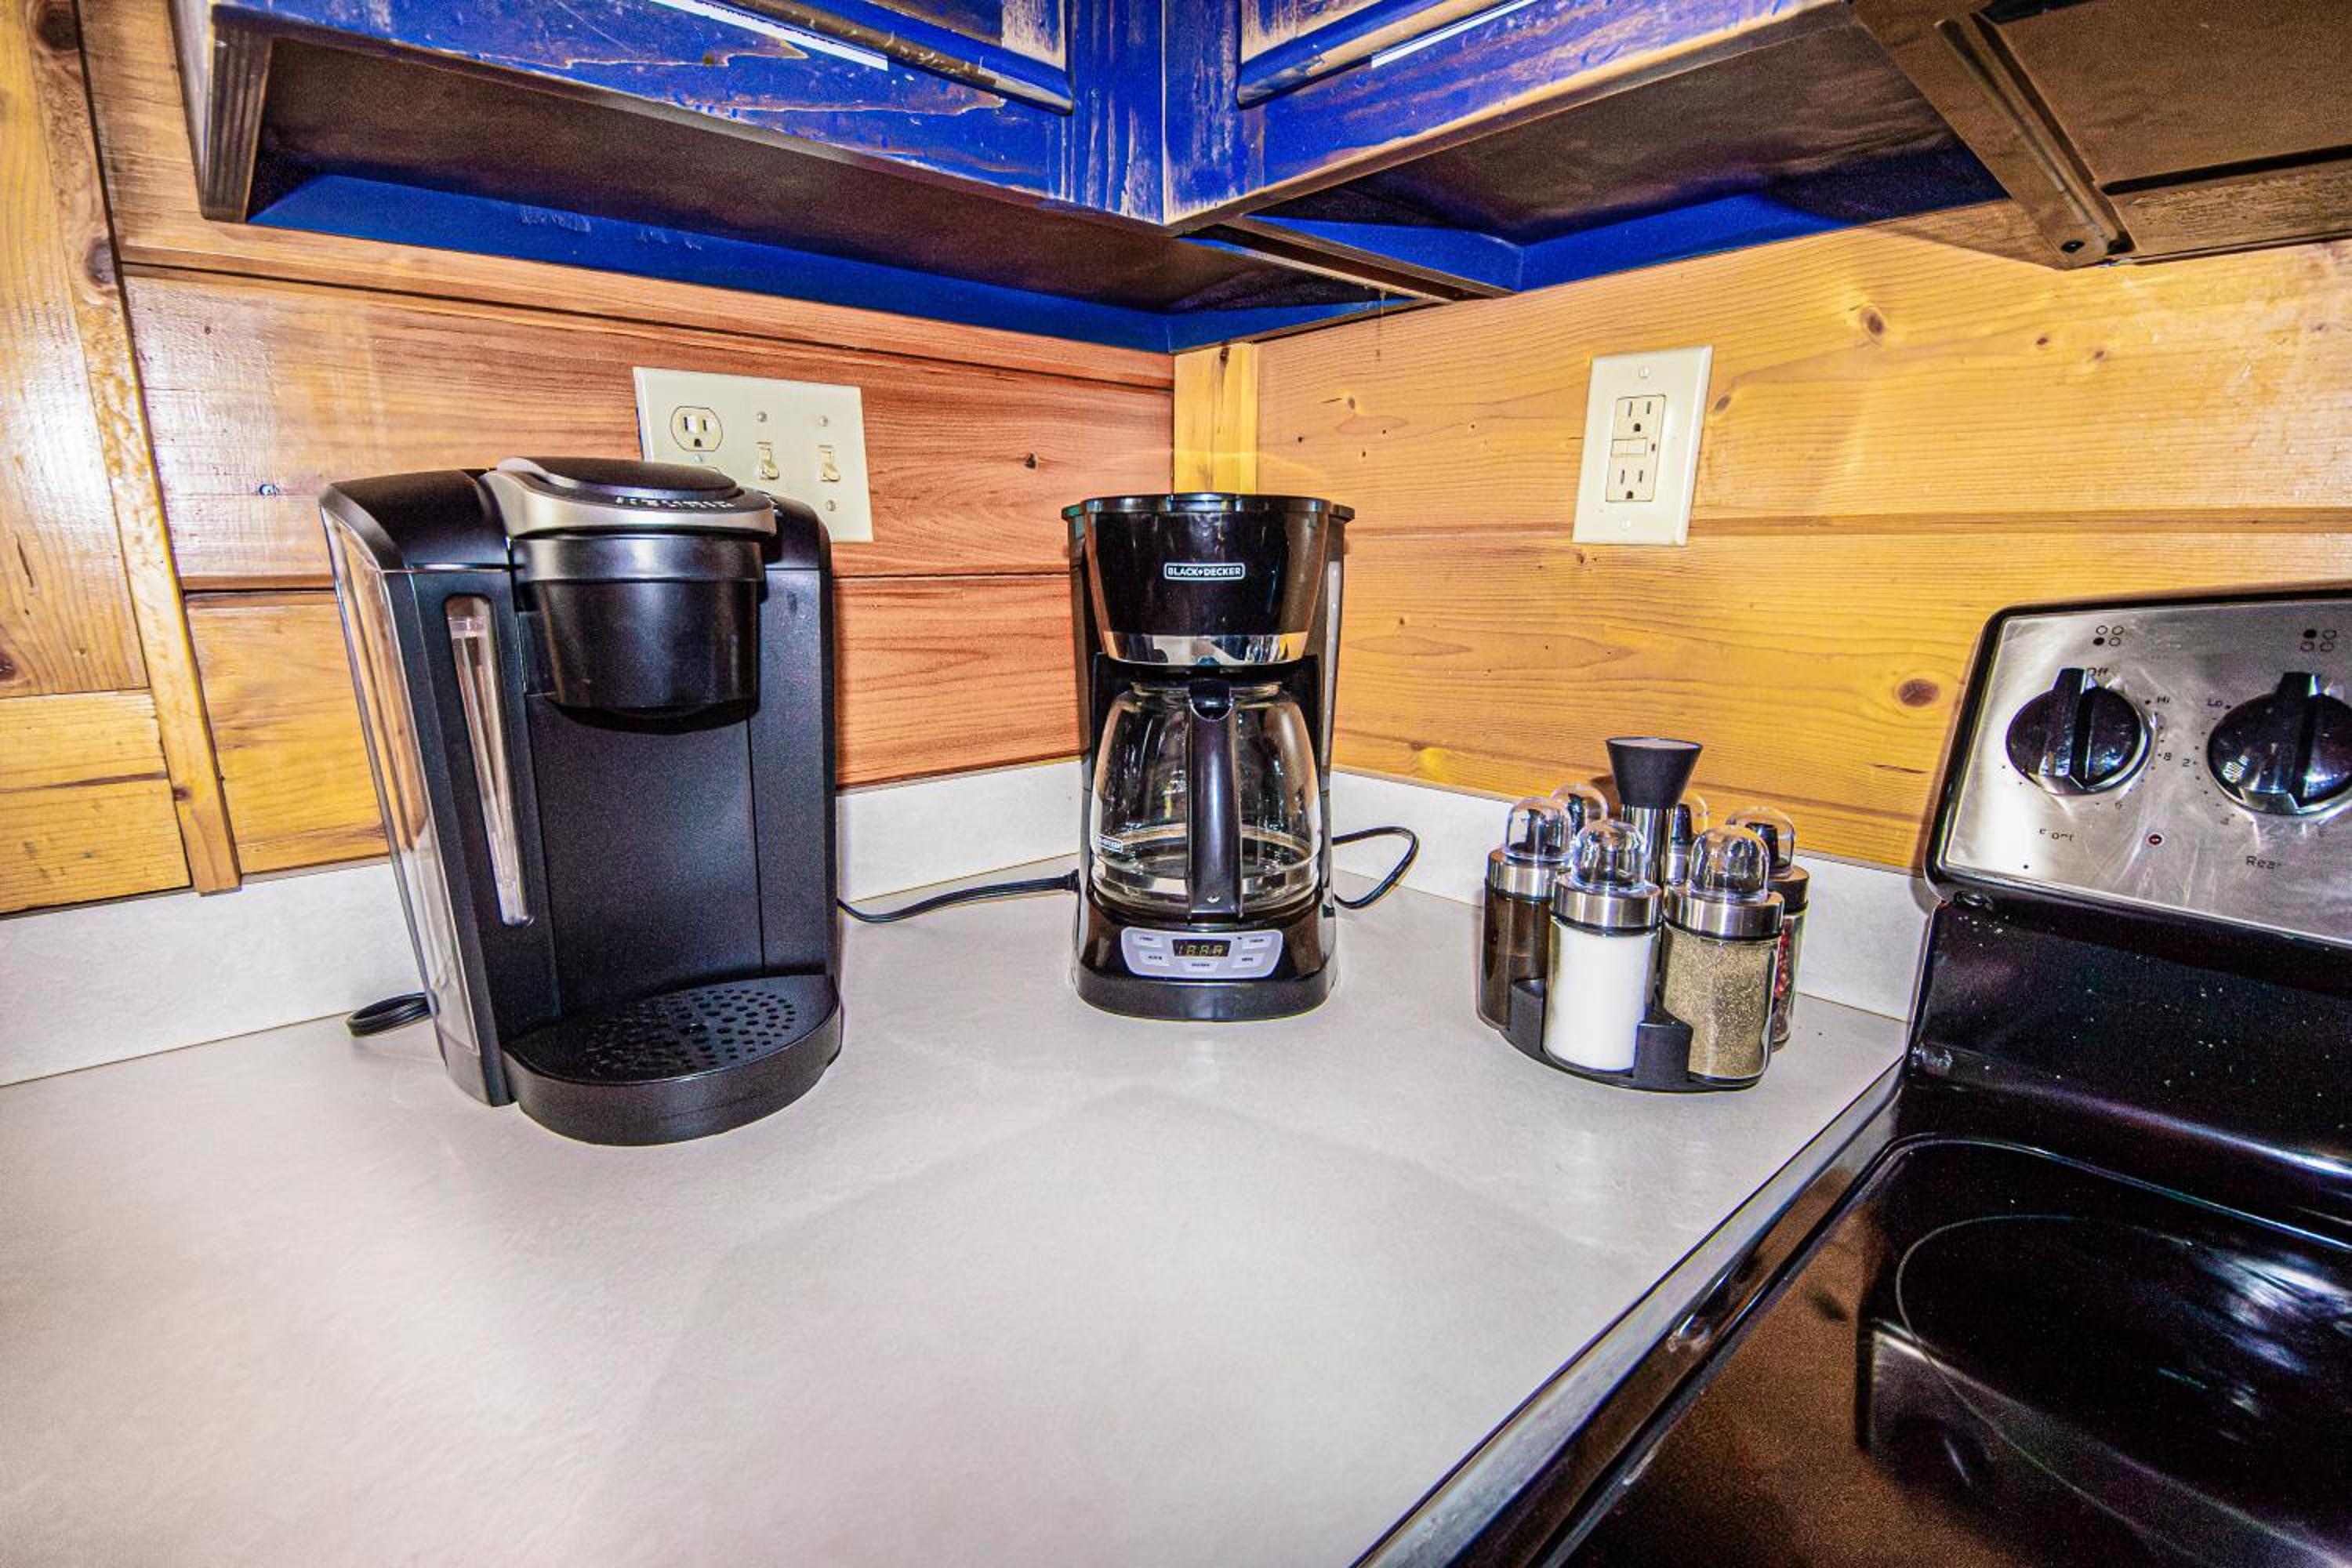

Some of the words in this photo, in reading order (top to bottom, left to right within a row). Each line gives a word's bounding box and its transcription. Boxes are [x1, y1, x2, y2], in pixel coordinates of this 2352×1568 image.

[1167, 567, 1241, 576] BLACK+DECKER
[2182, 758, 2190, 768] 2
[2039, 828, 2074, 841] Font
